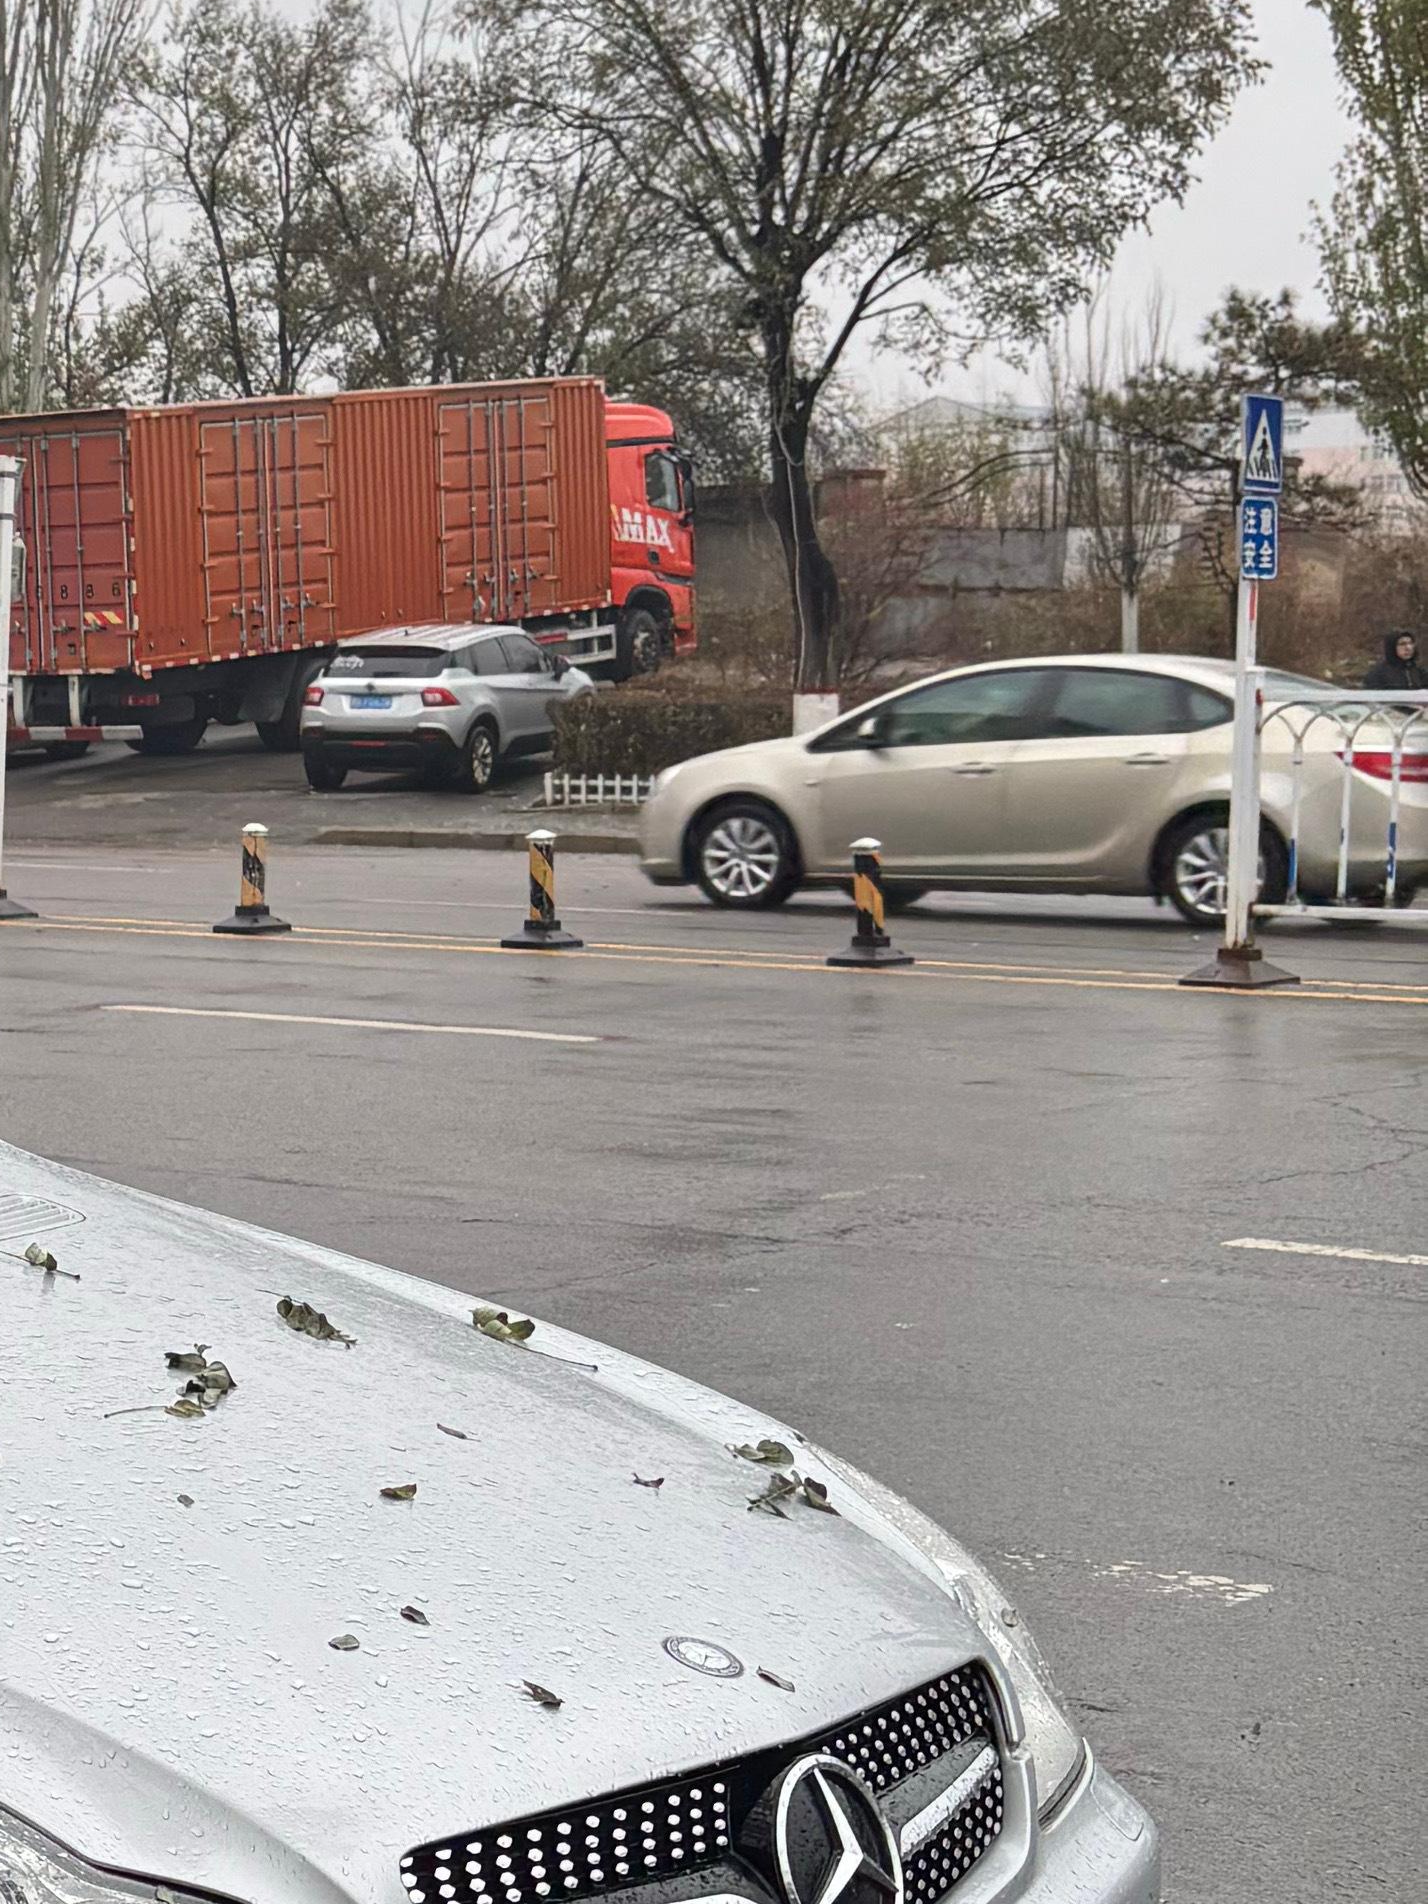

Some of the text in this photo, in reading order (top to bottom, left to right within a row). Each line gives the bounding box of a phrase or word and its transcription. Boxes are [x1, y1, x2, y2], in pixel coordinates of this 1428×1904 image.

[620, 508, 674, 552] MAX
[1244, 506, 1273, 536] 注意
[1243, 539, 1273, 569] 安全
